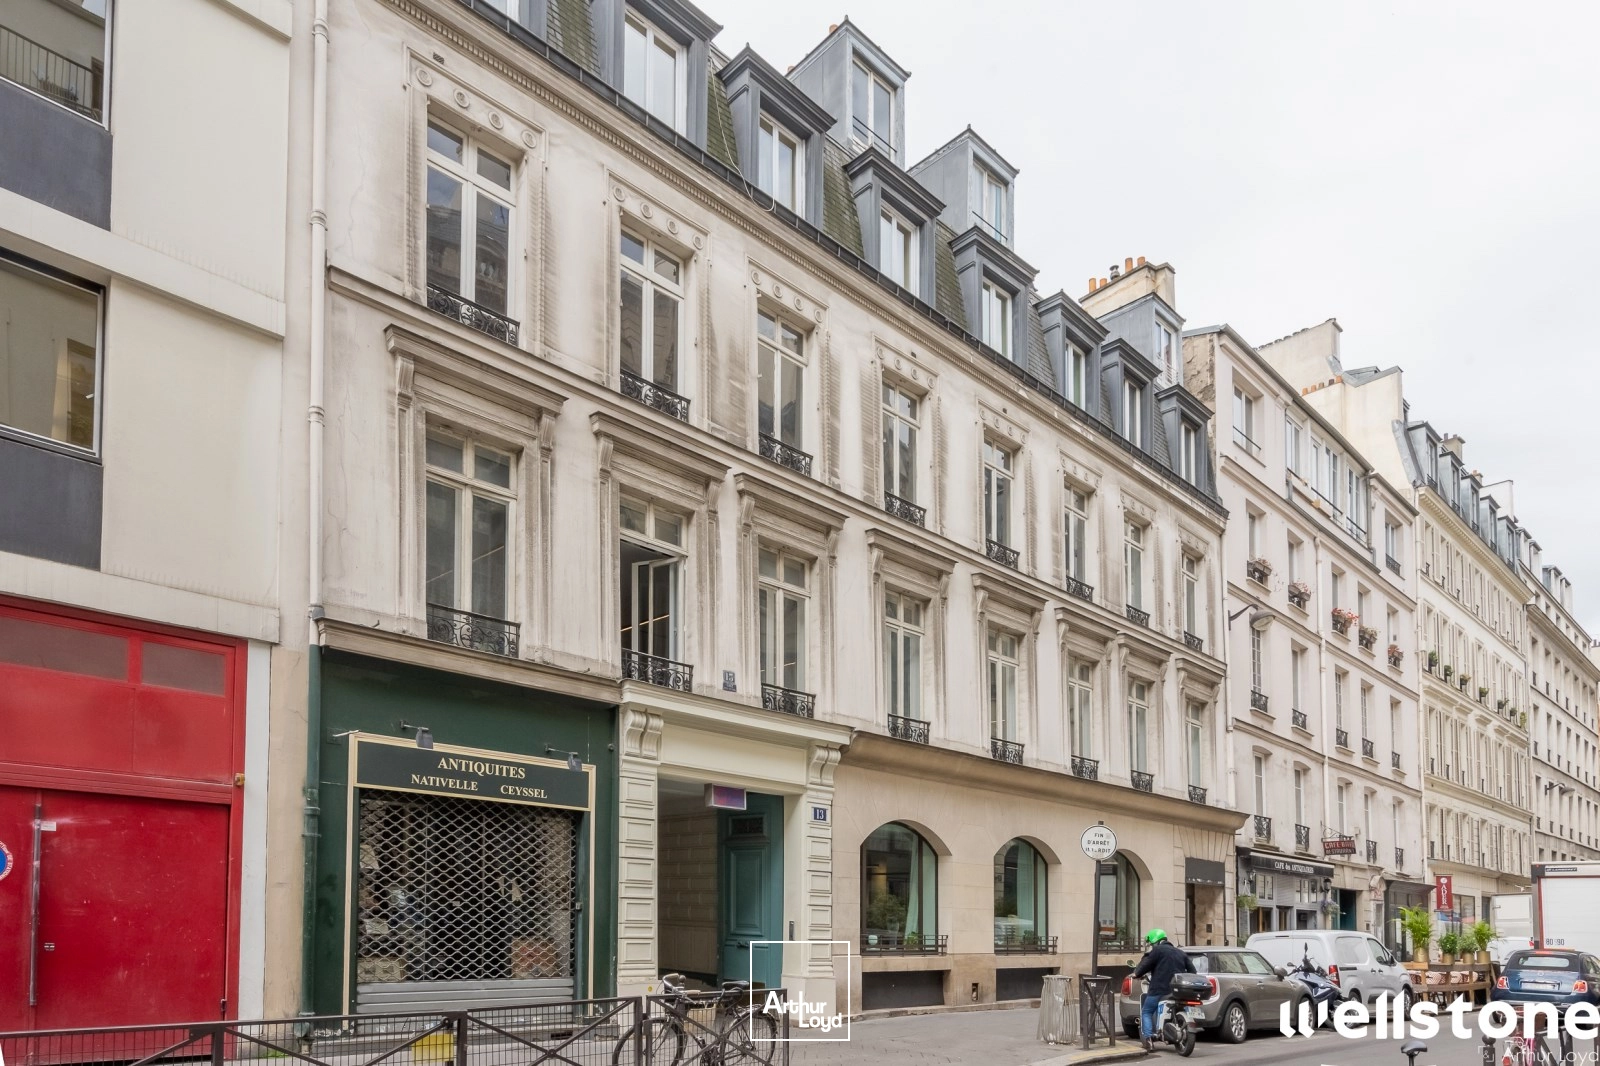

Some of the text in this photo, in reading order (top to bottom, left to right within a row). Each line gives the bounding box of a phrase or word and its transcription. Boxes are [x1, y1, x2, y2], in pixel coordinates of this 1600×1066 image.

[437, 757, 526, 779] ANTIQUITES
[411, 774, 548, 799] NATIVELLE CEYSSEL
[816, 808, 824, 820] 13
